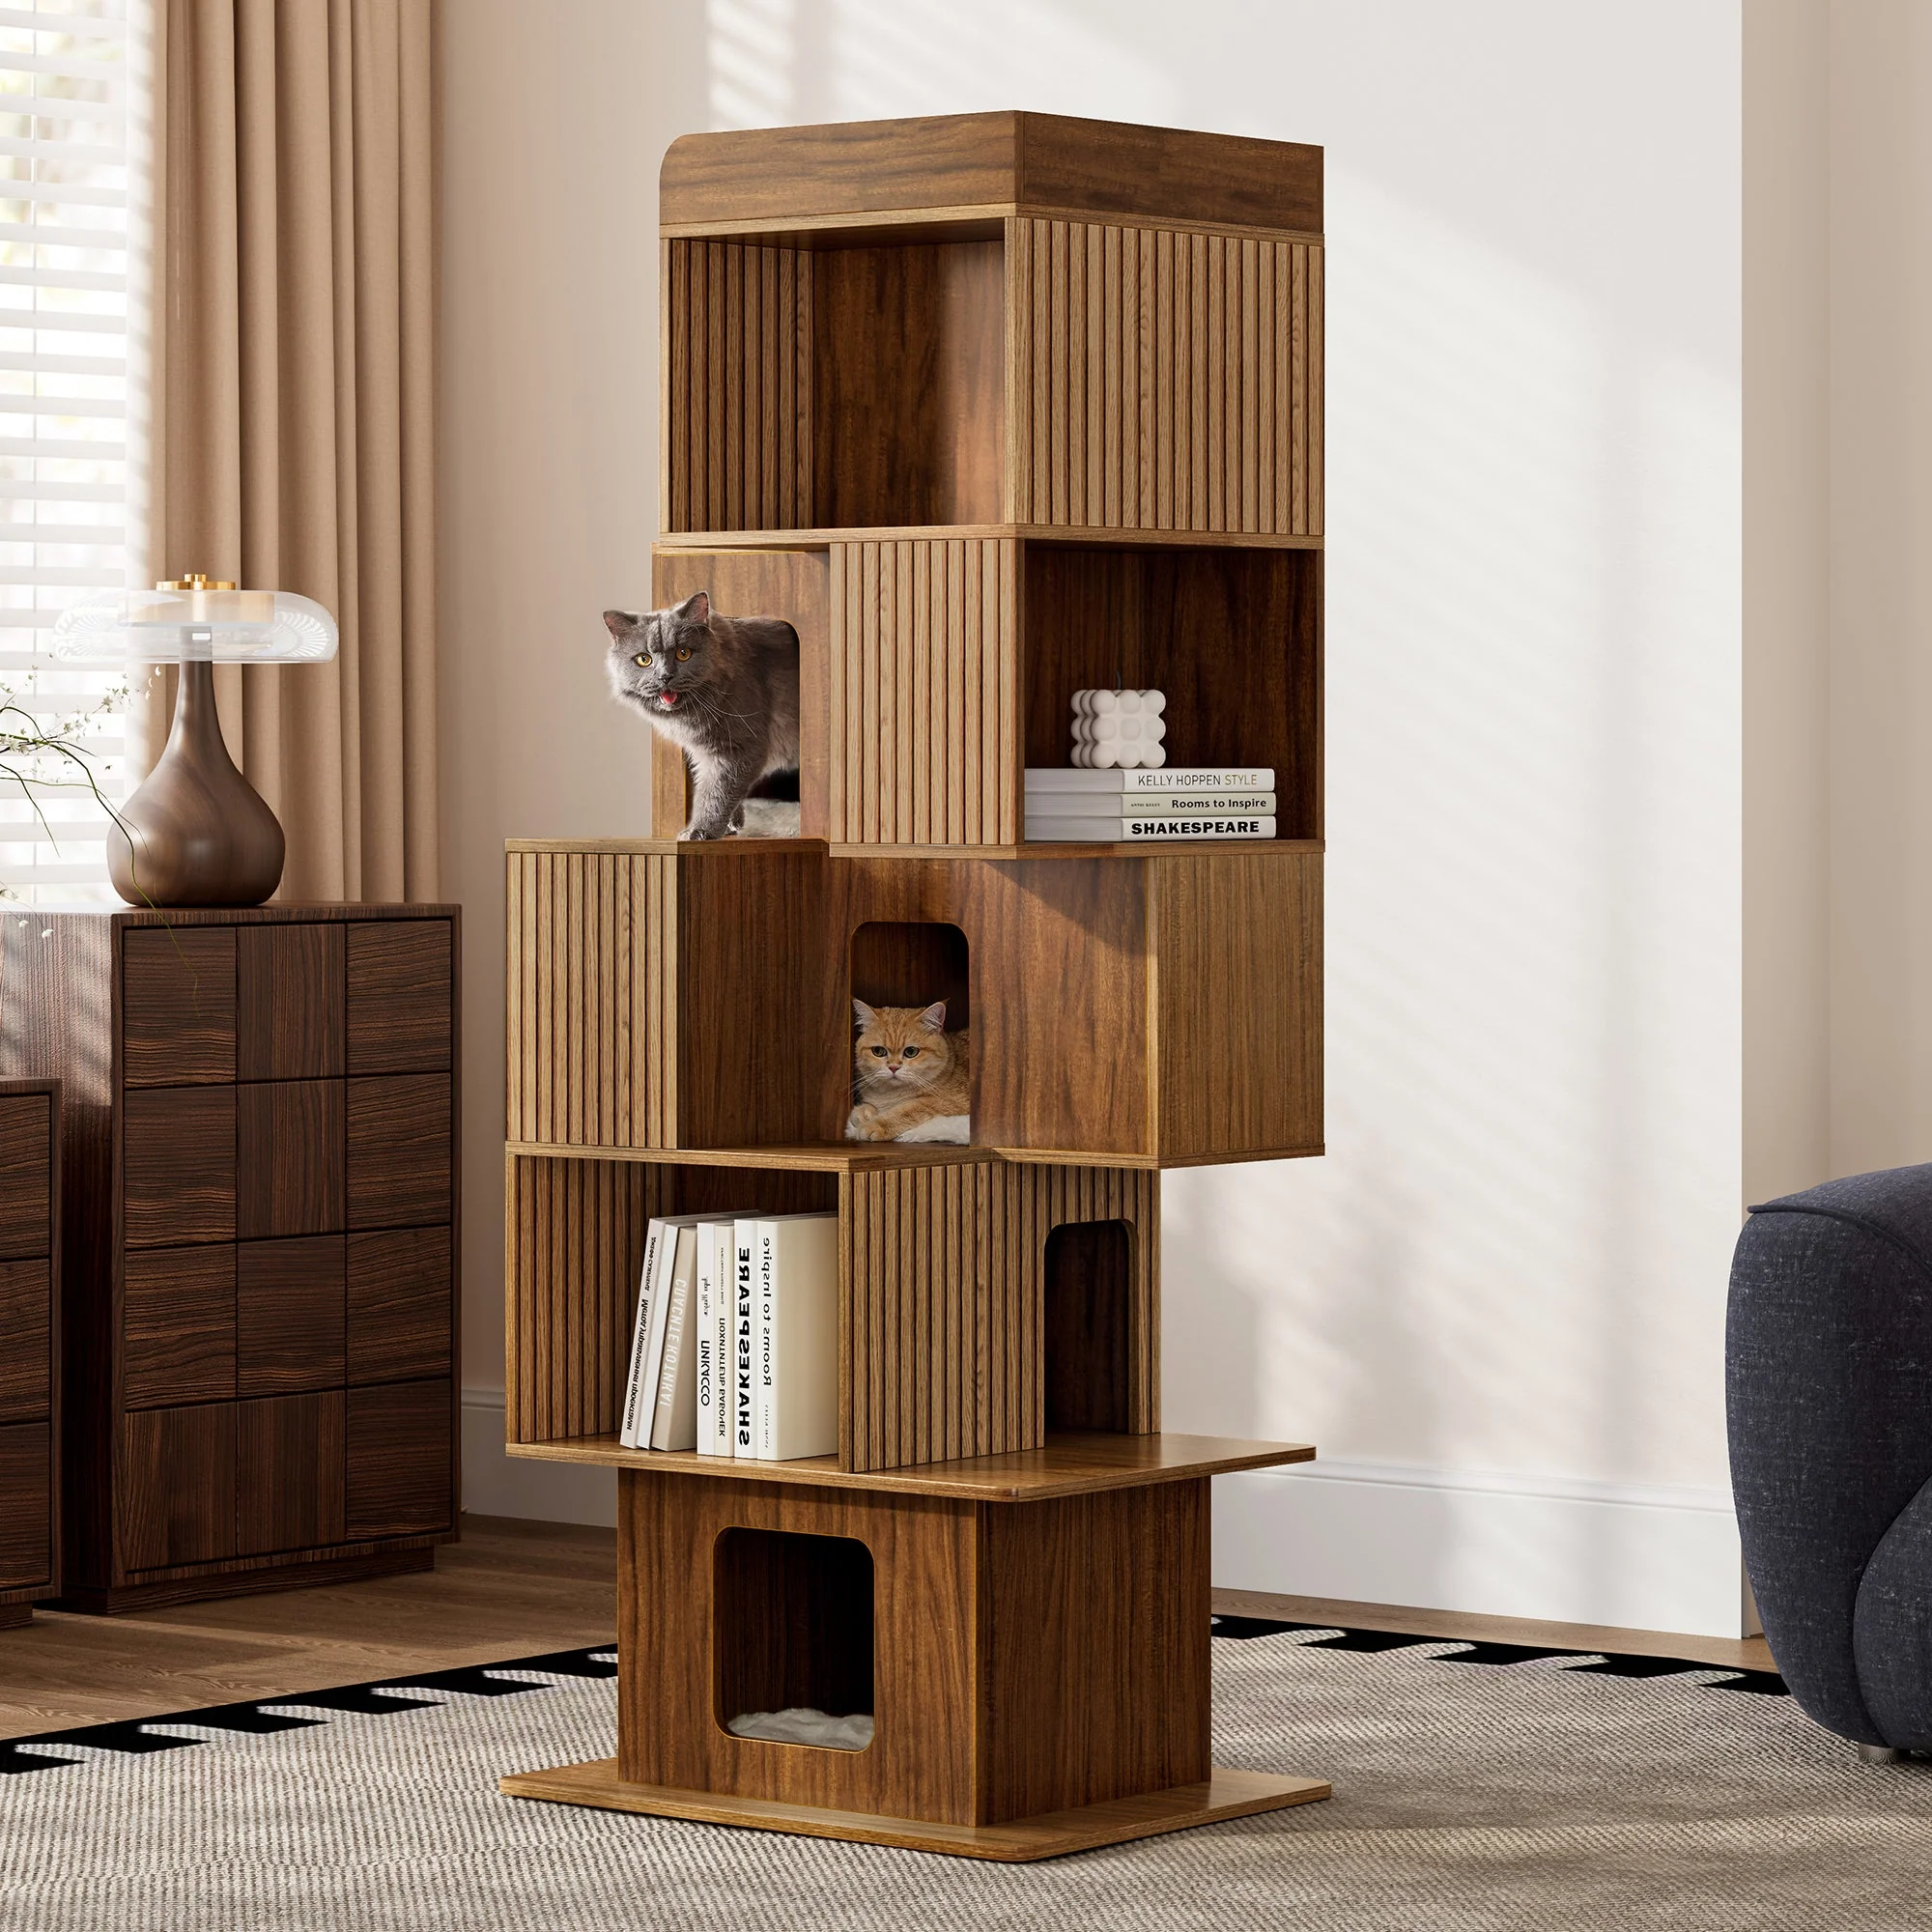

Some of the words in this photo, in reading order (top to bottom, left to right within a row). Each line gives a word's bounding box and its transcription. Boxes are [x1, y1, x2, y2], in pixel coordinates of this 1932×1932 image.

[1138, 775, 1173, 786] KELLY
[1176, 775, 1221, 785] HOPPEN
[1224, 774, 1258, 785] STYLE
[1172, 799, 1209, 809] Rooms
[1213, 799, 1225, 809] to
[1228, 798, 1267, 810] Inspire
[1131, 821, 1260, 835] SHAKESPEARE
